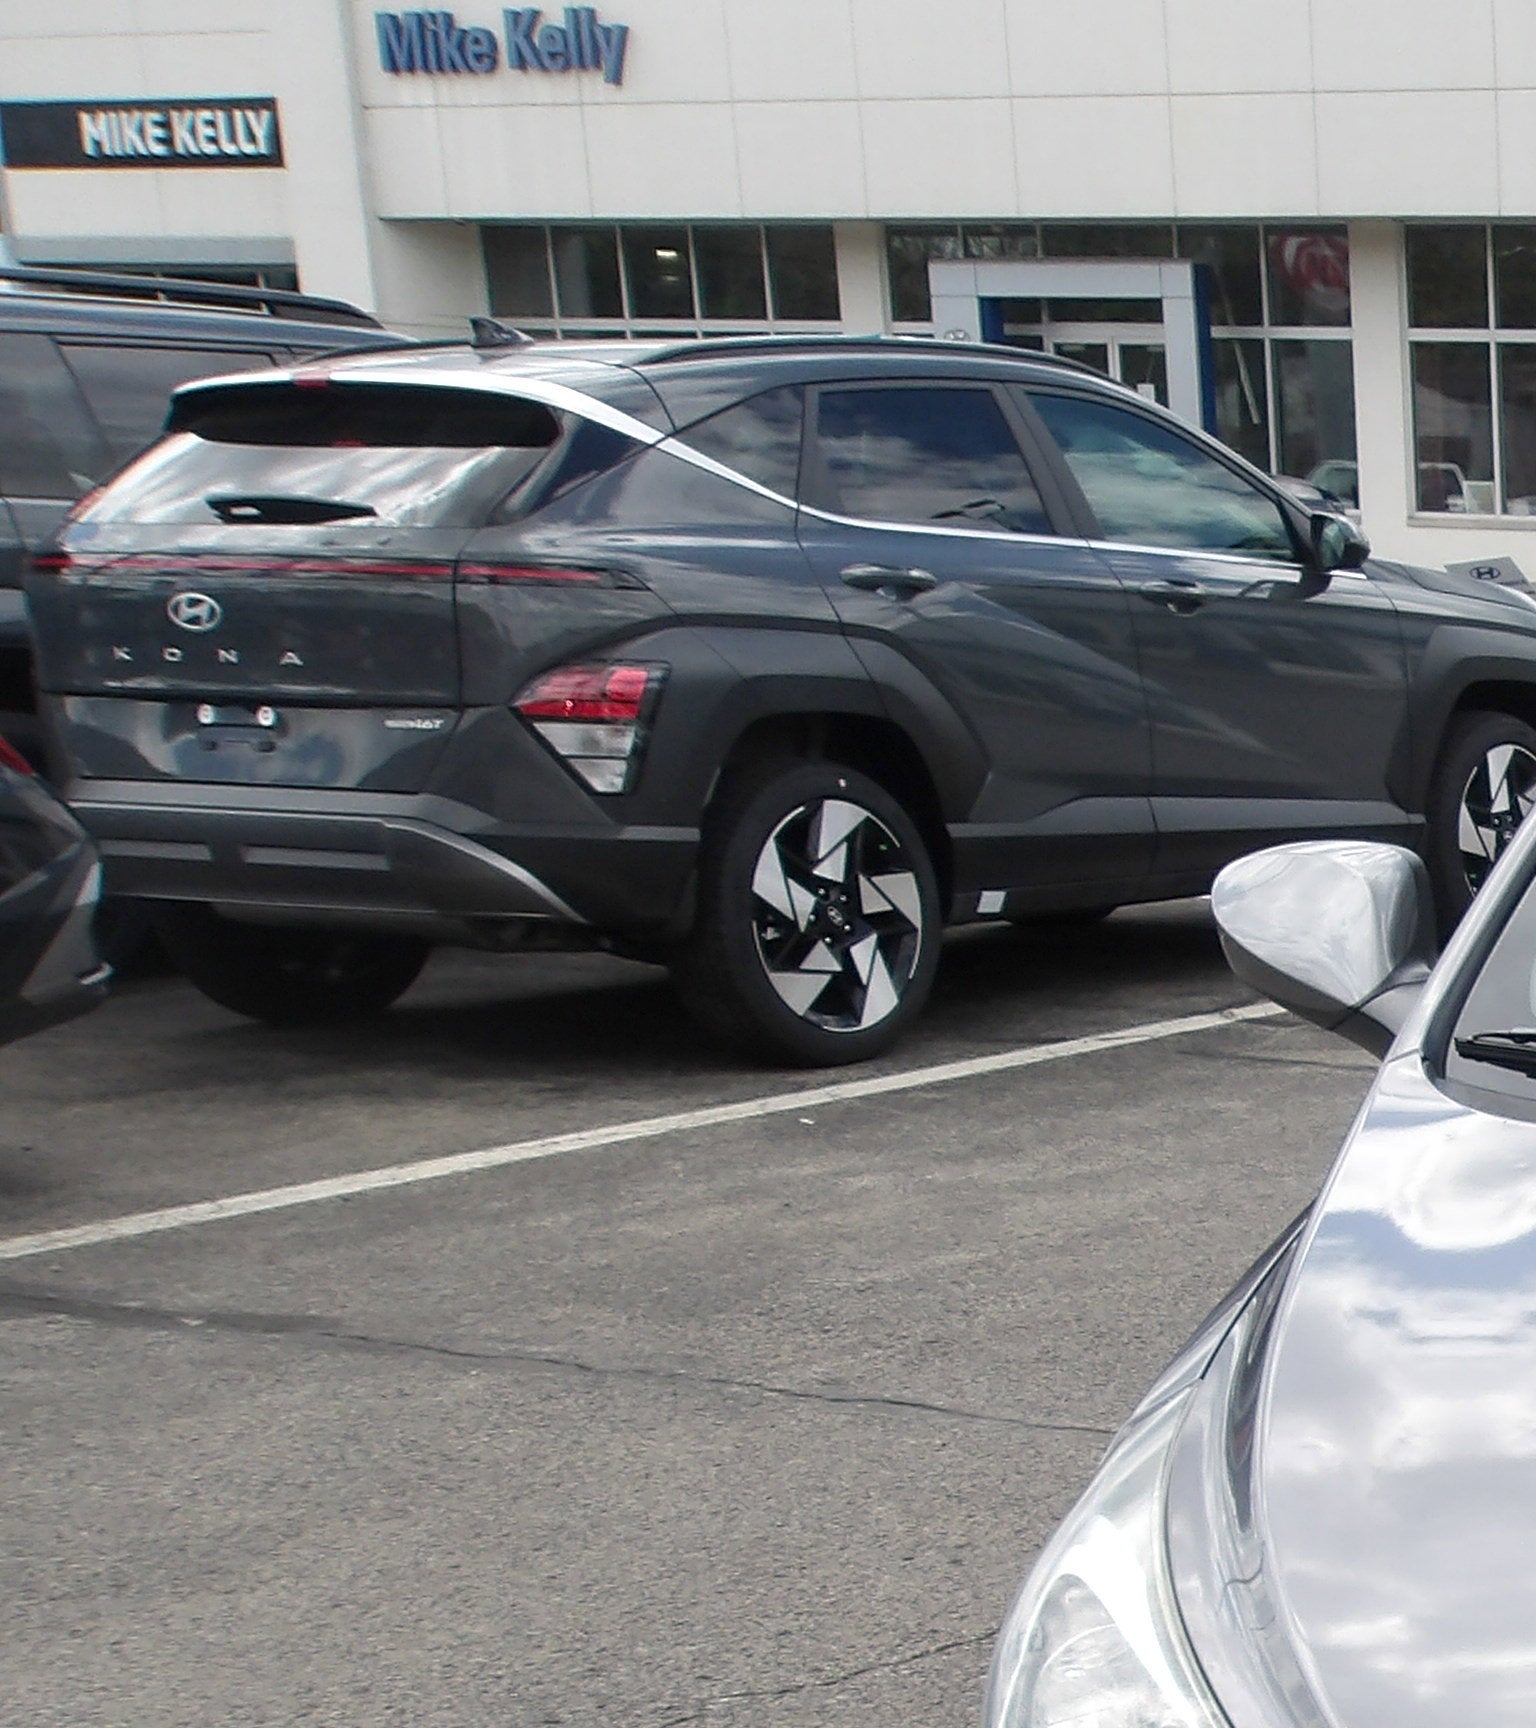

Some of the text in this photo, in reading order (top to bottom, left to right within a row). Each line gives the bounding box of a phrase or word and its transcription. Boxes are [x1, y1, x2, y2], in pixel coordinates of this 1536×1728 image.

[374, 6, 629, 86] Mike Kelly
[79, 107, 273, 158] MIKE KELLY
[112, 645, 304, 667] KONA
